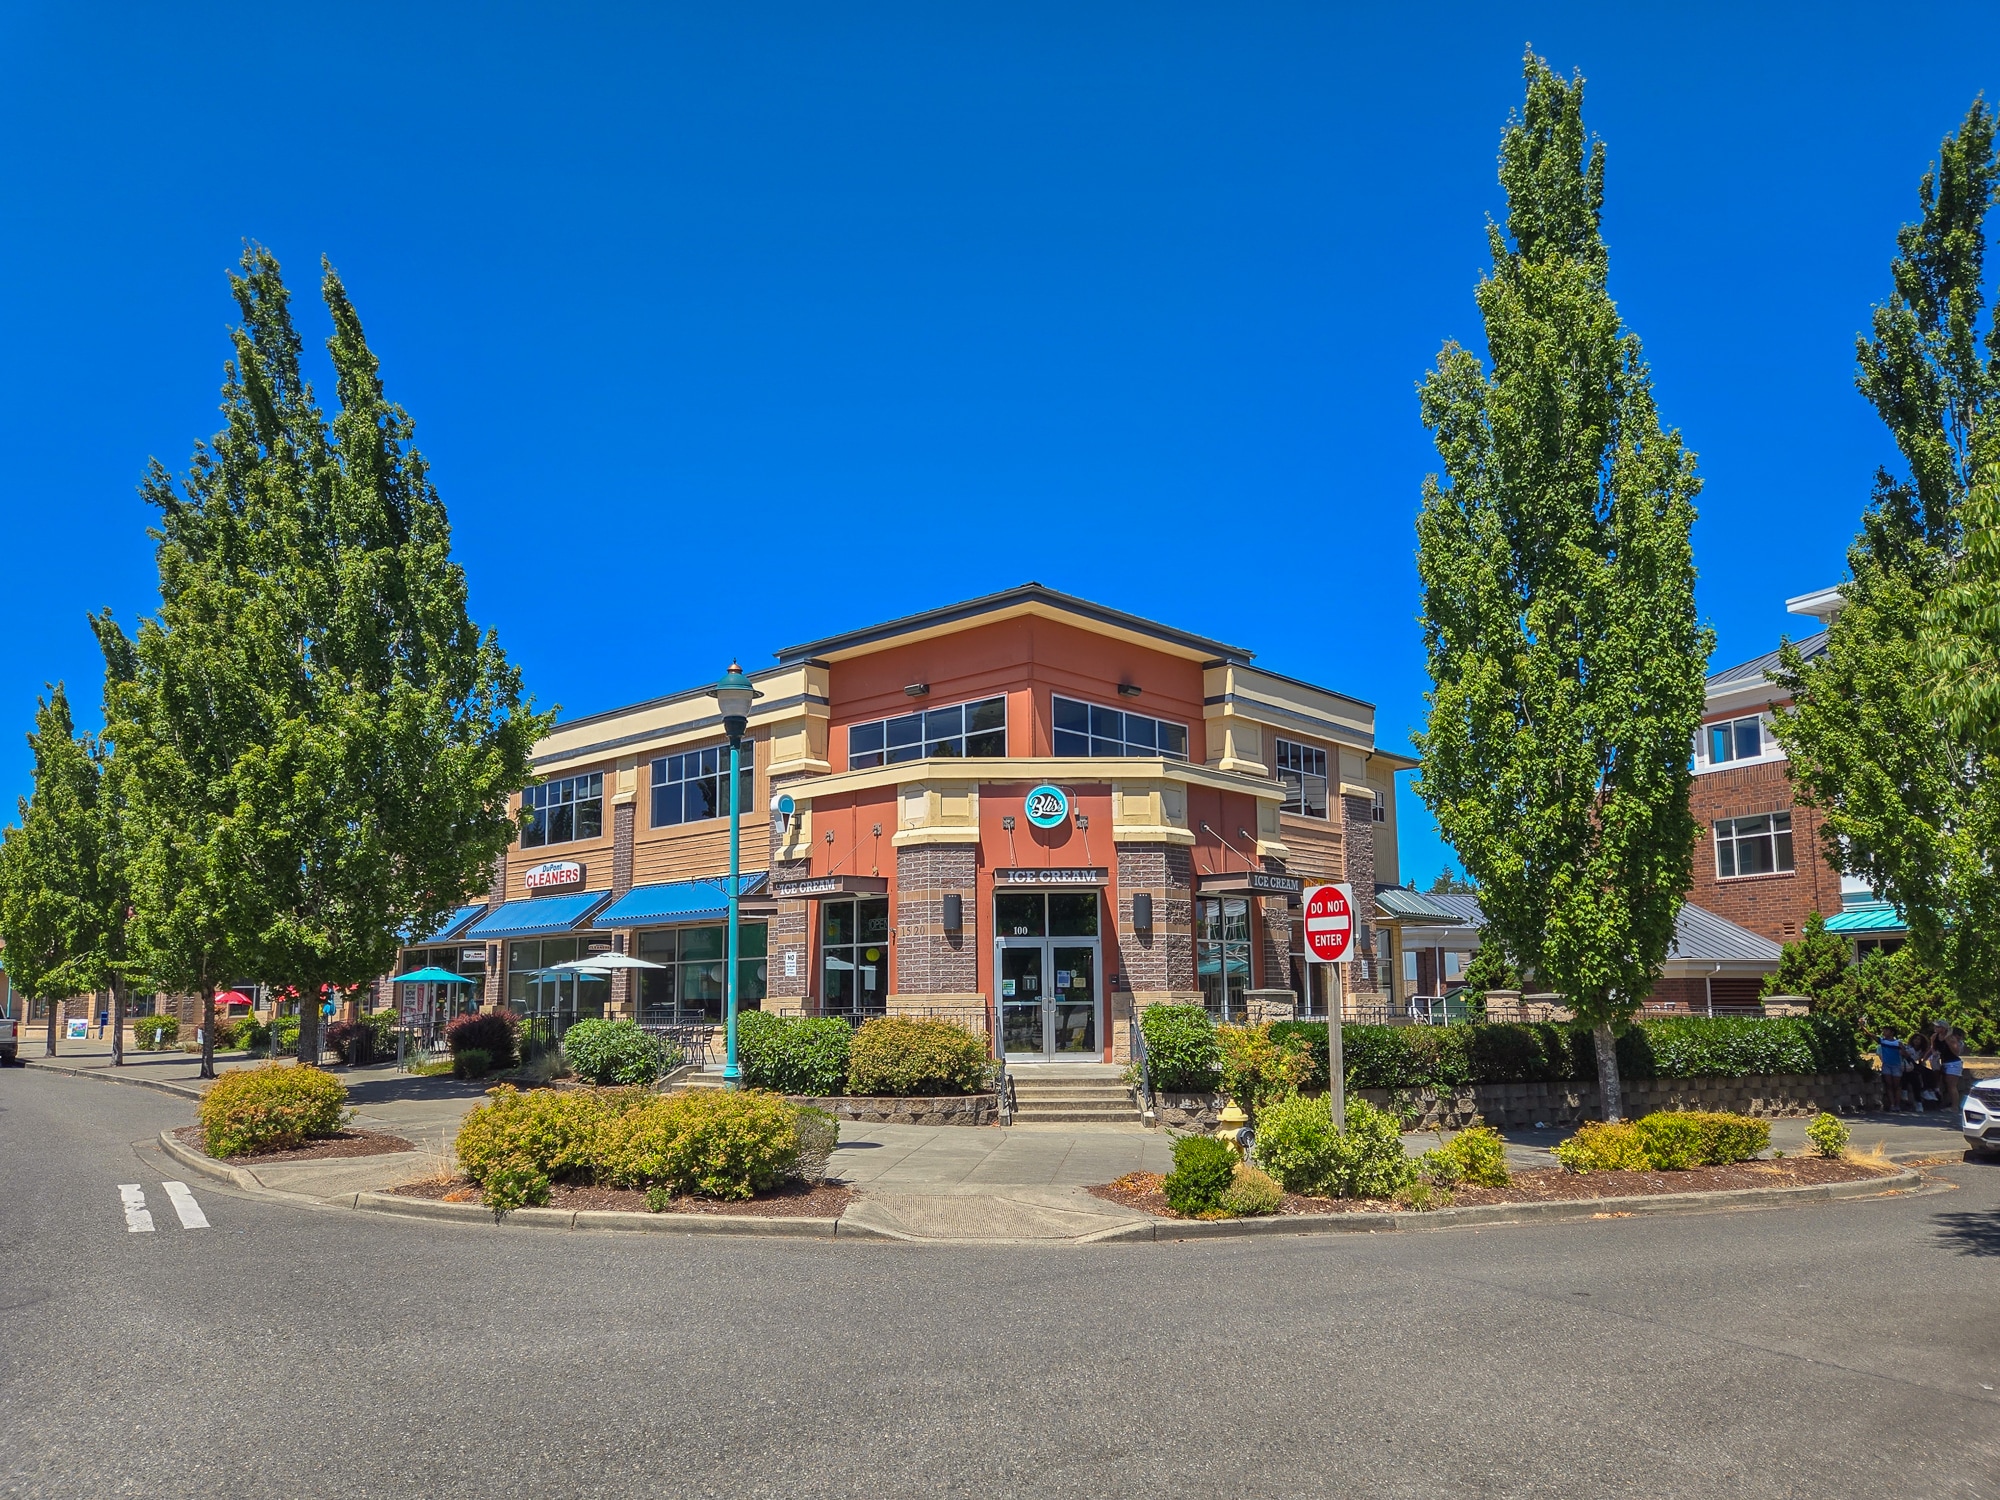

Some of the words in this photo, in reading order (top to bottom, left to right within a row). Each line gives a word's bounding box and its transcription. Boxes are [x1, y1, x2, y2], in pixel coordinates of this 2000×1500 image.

[1029, 794, 1064, 817] Bliss
[542, 863, 563, 873] DuPont
[526, 868, 579, 887] CLEANERS
[1008, 871, 1036, 883] ICE
[1039, 870, 1097, 882] CREAM
[1254, 875, 1269, 887] ICE
[1270, 877, 1299, 891] CREAM
[780, 882, 798, 895] ICE
[799, 879, 836, 893] CREAM
[1311, 902, 1323, 914] DO
[1327, 900, 1344, 913] NOT
[901, 925, 926, 937] 1520
[1013, 926, 1028, 935] 100
[1315, 934, 1342, 946] ENTER
